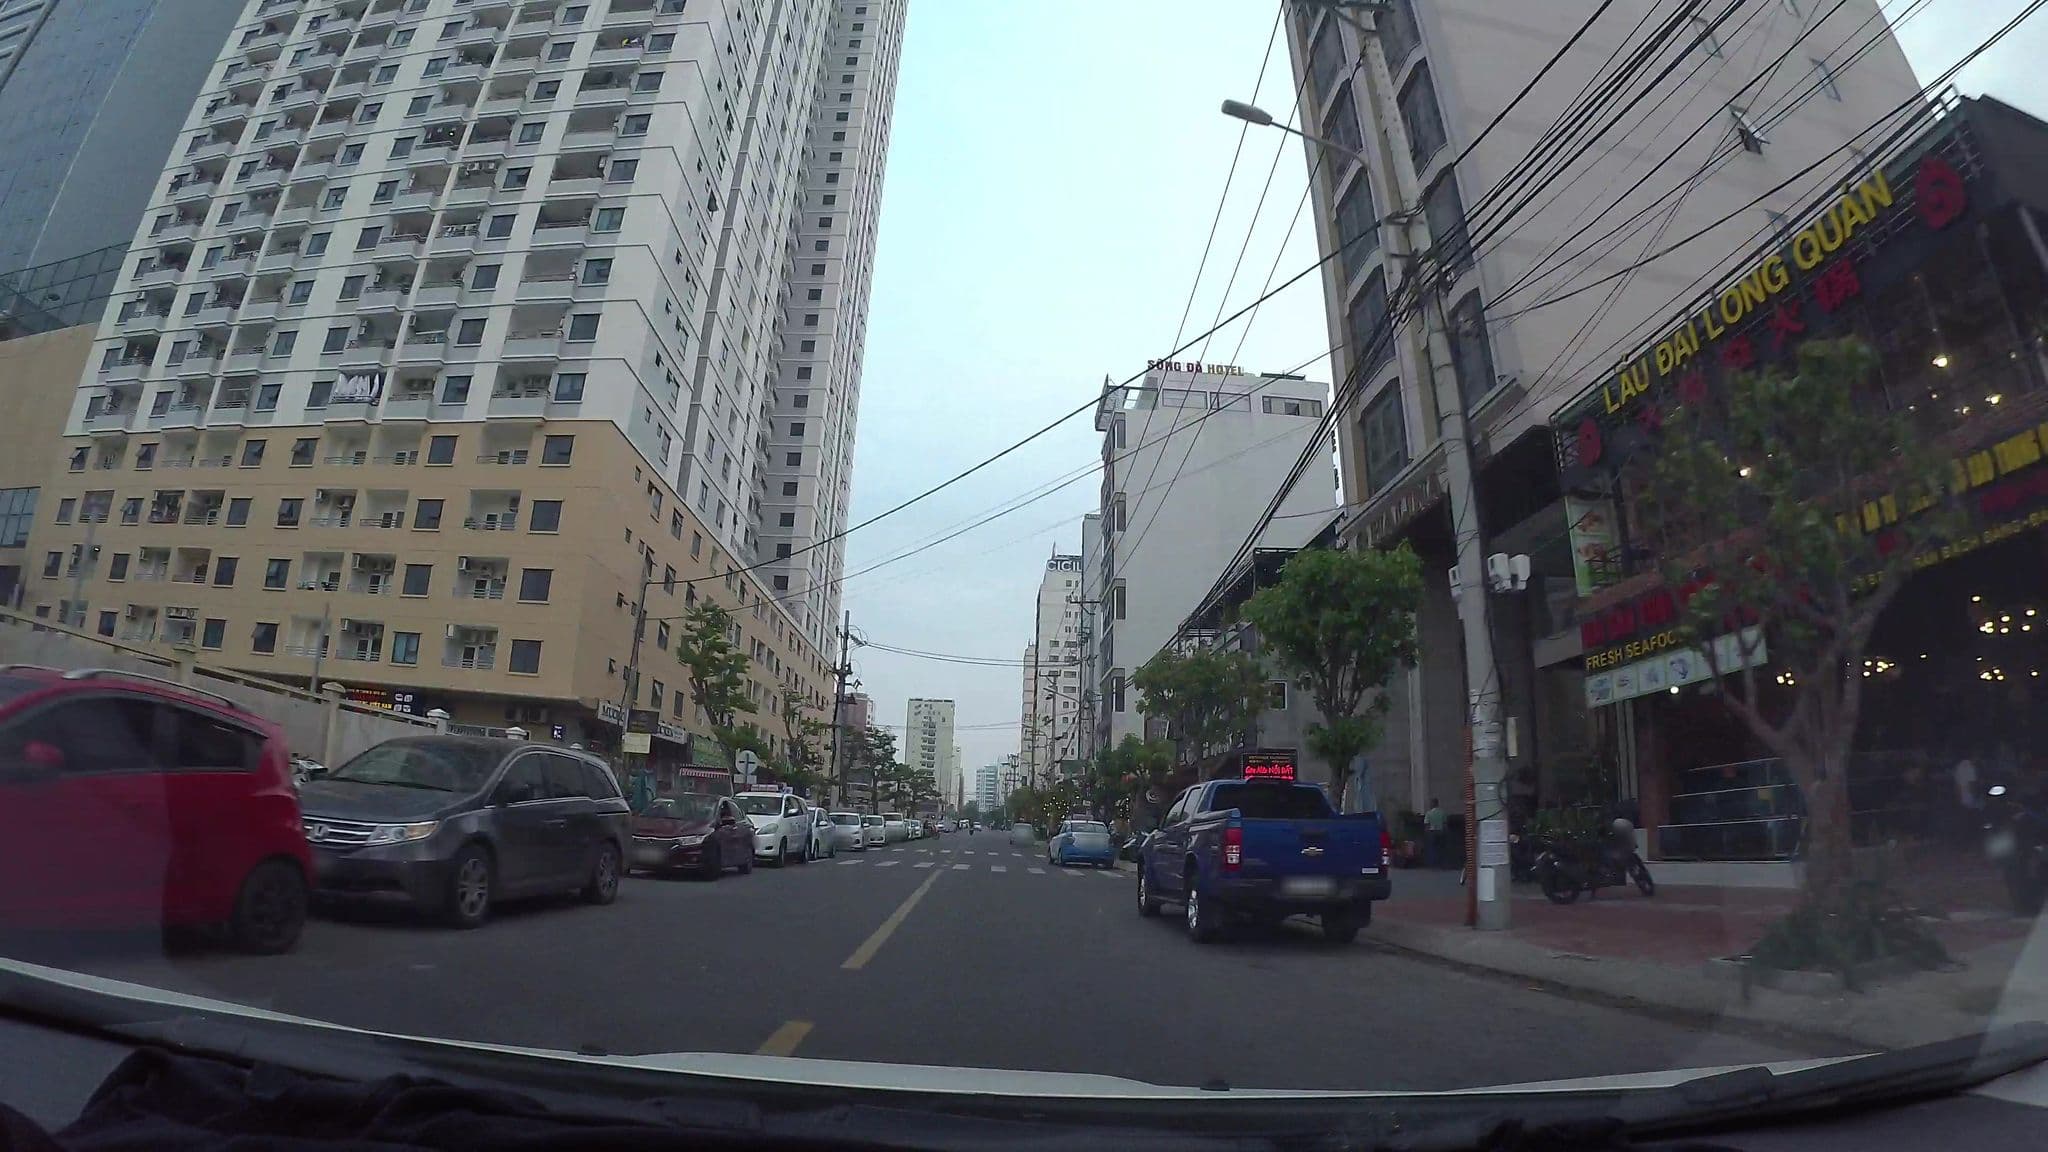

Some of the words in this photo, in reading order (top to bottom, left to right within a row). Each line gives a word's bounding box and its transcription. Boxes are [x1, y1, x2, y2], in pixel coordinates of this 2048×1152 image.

[1703, 255, 1790, 340] LONG
[1792, 169, 1893, 270] QUÁN
[1207, 364, 1244, 376] HOTEL
[1586, 647, 1624, 672] FRESH
